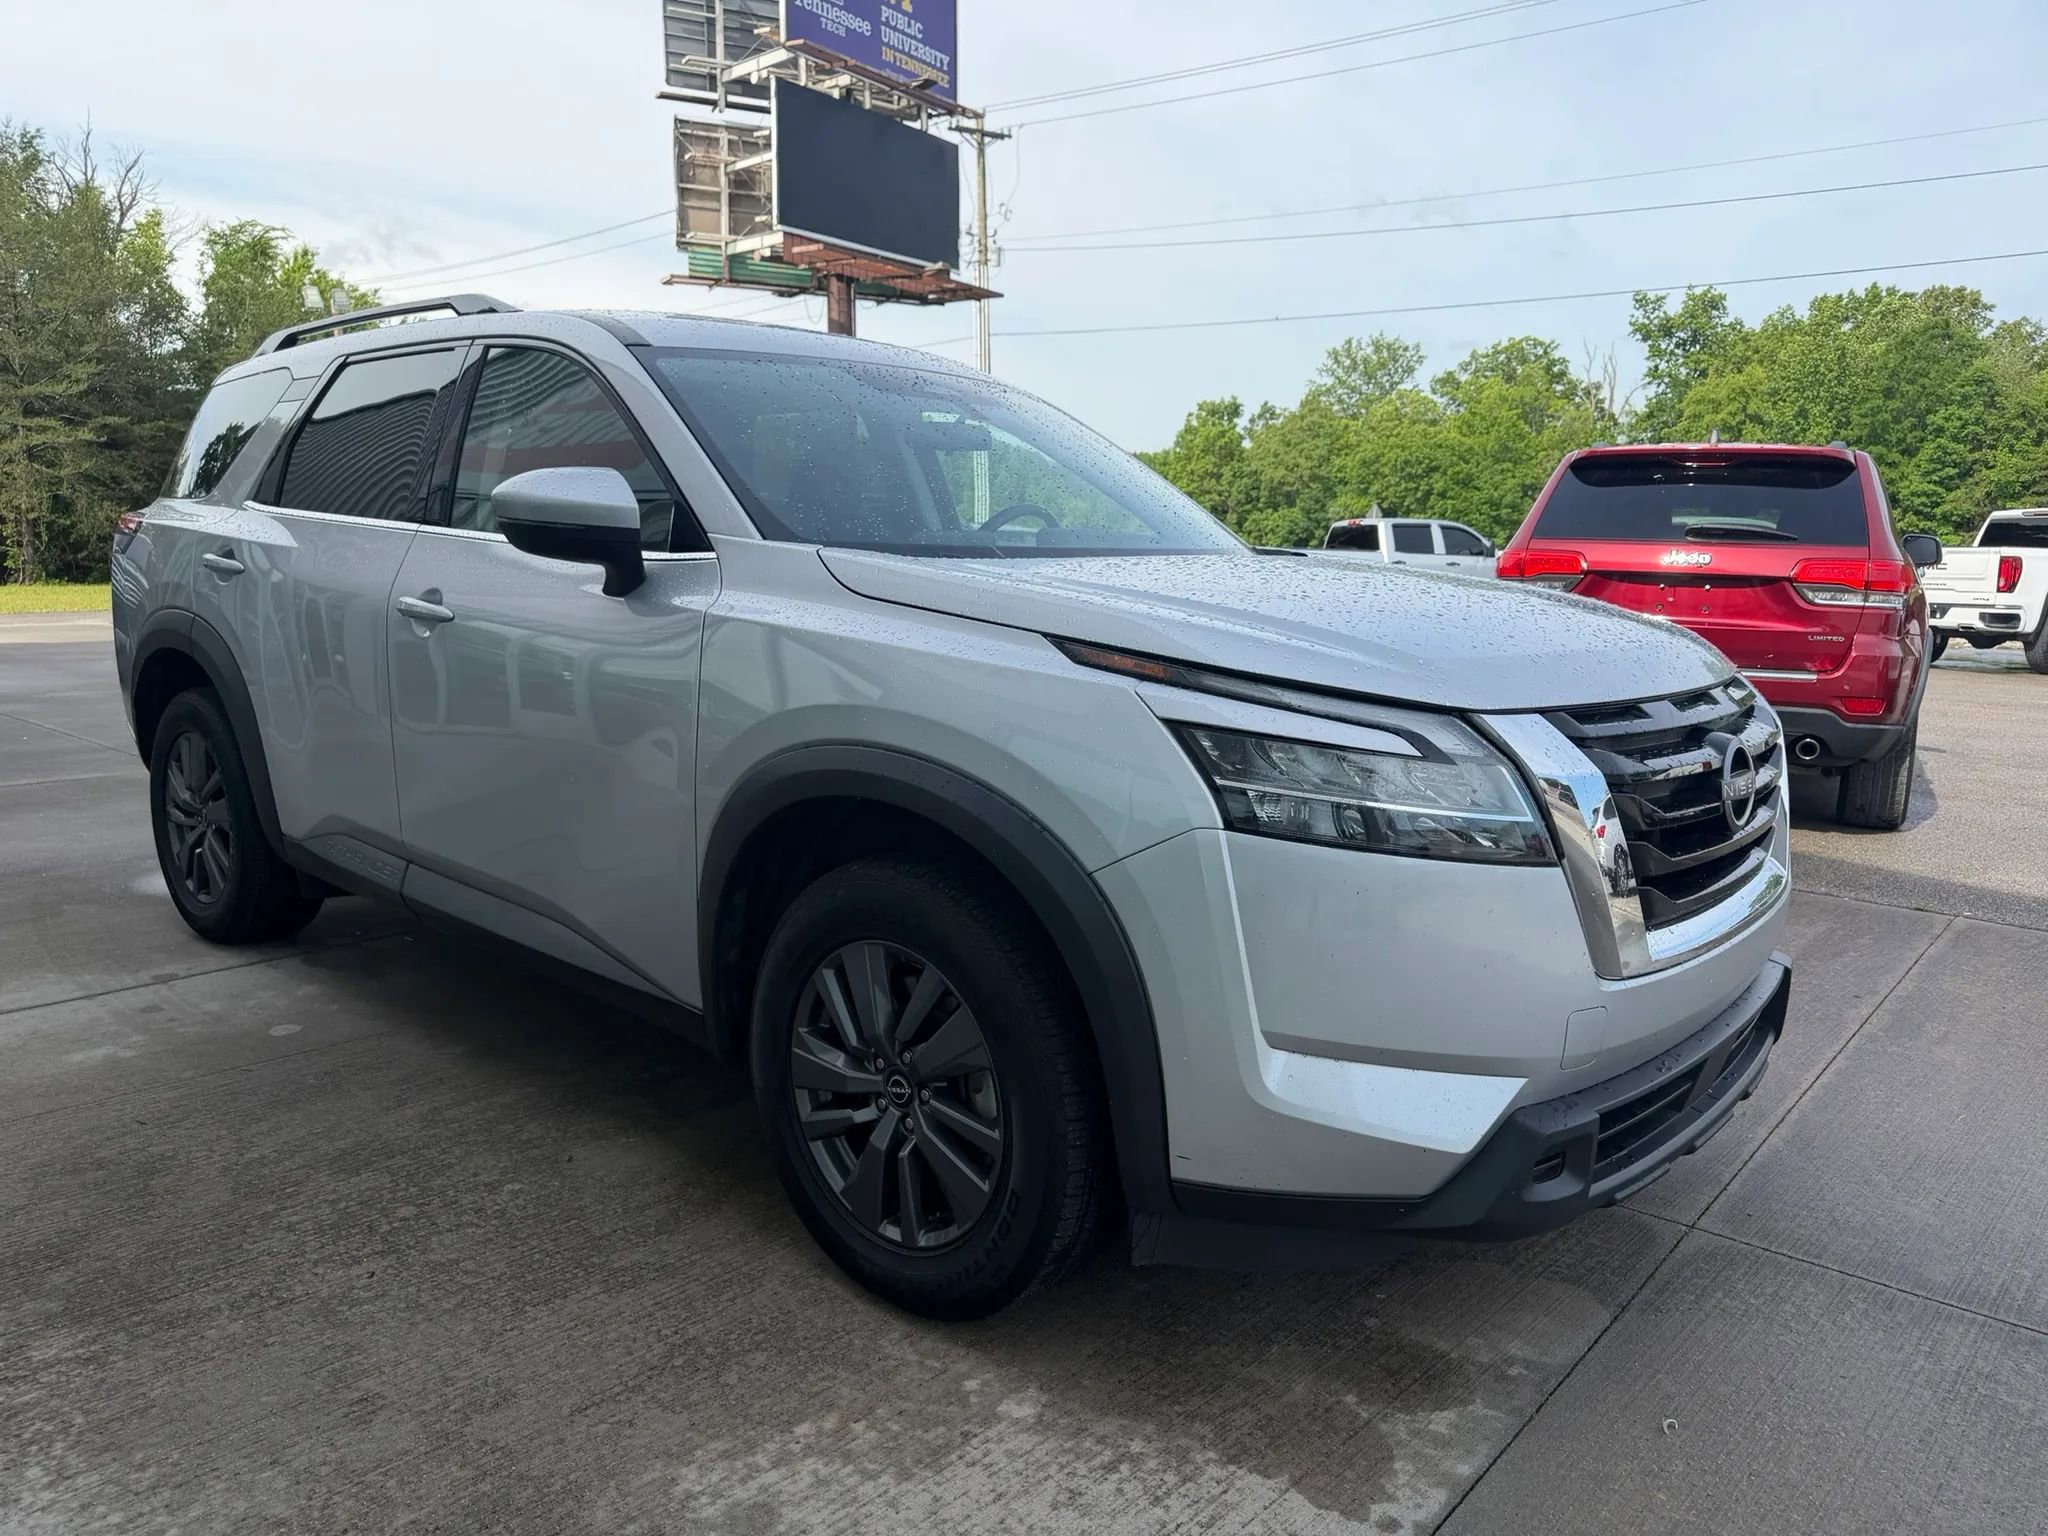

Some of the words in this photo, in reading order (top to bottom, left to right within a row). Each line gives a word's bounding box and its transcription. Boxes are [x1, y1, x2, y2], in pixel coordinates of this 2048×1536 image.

[820, 17, 846, 37] TECH
[880, 5, 923, 39] PUBLIC
[880, 25, 950, 71] UNIVERSITY
[881, 46, 895, 64] IN
[1661, 549, 1713, 566] Jeep
[1808, 634, 1845, 642] LIMITED
